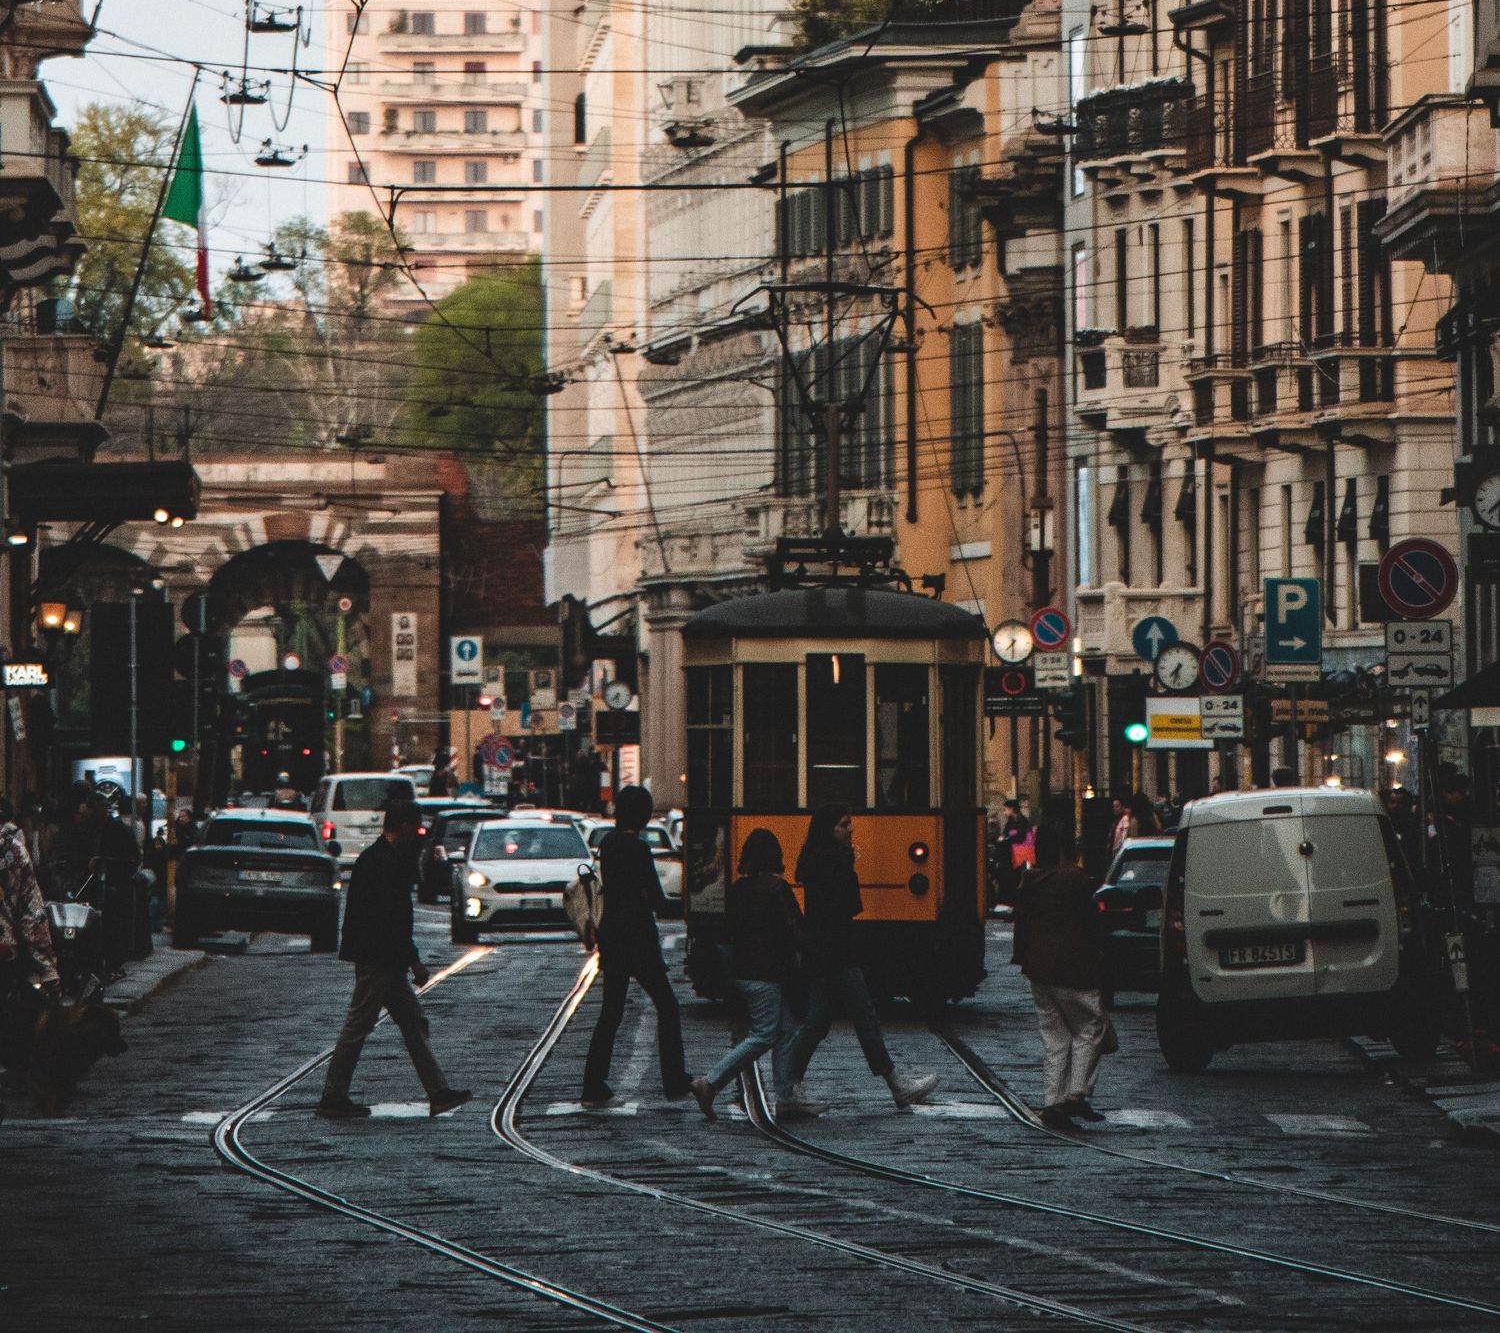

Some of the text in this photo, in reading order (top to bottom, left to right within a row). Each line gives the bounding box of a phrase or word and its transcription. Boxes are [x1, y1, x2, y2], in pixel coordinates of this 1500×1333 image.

[1277, 584, 1308, 624] P
[1420, 629, 1443, 644] 24
[4, 664, 43, 679] KARL
[1222, 700, 1238, 710] 24
